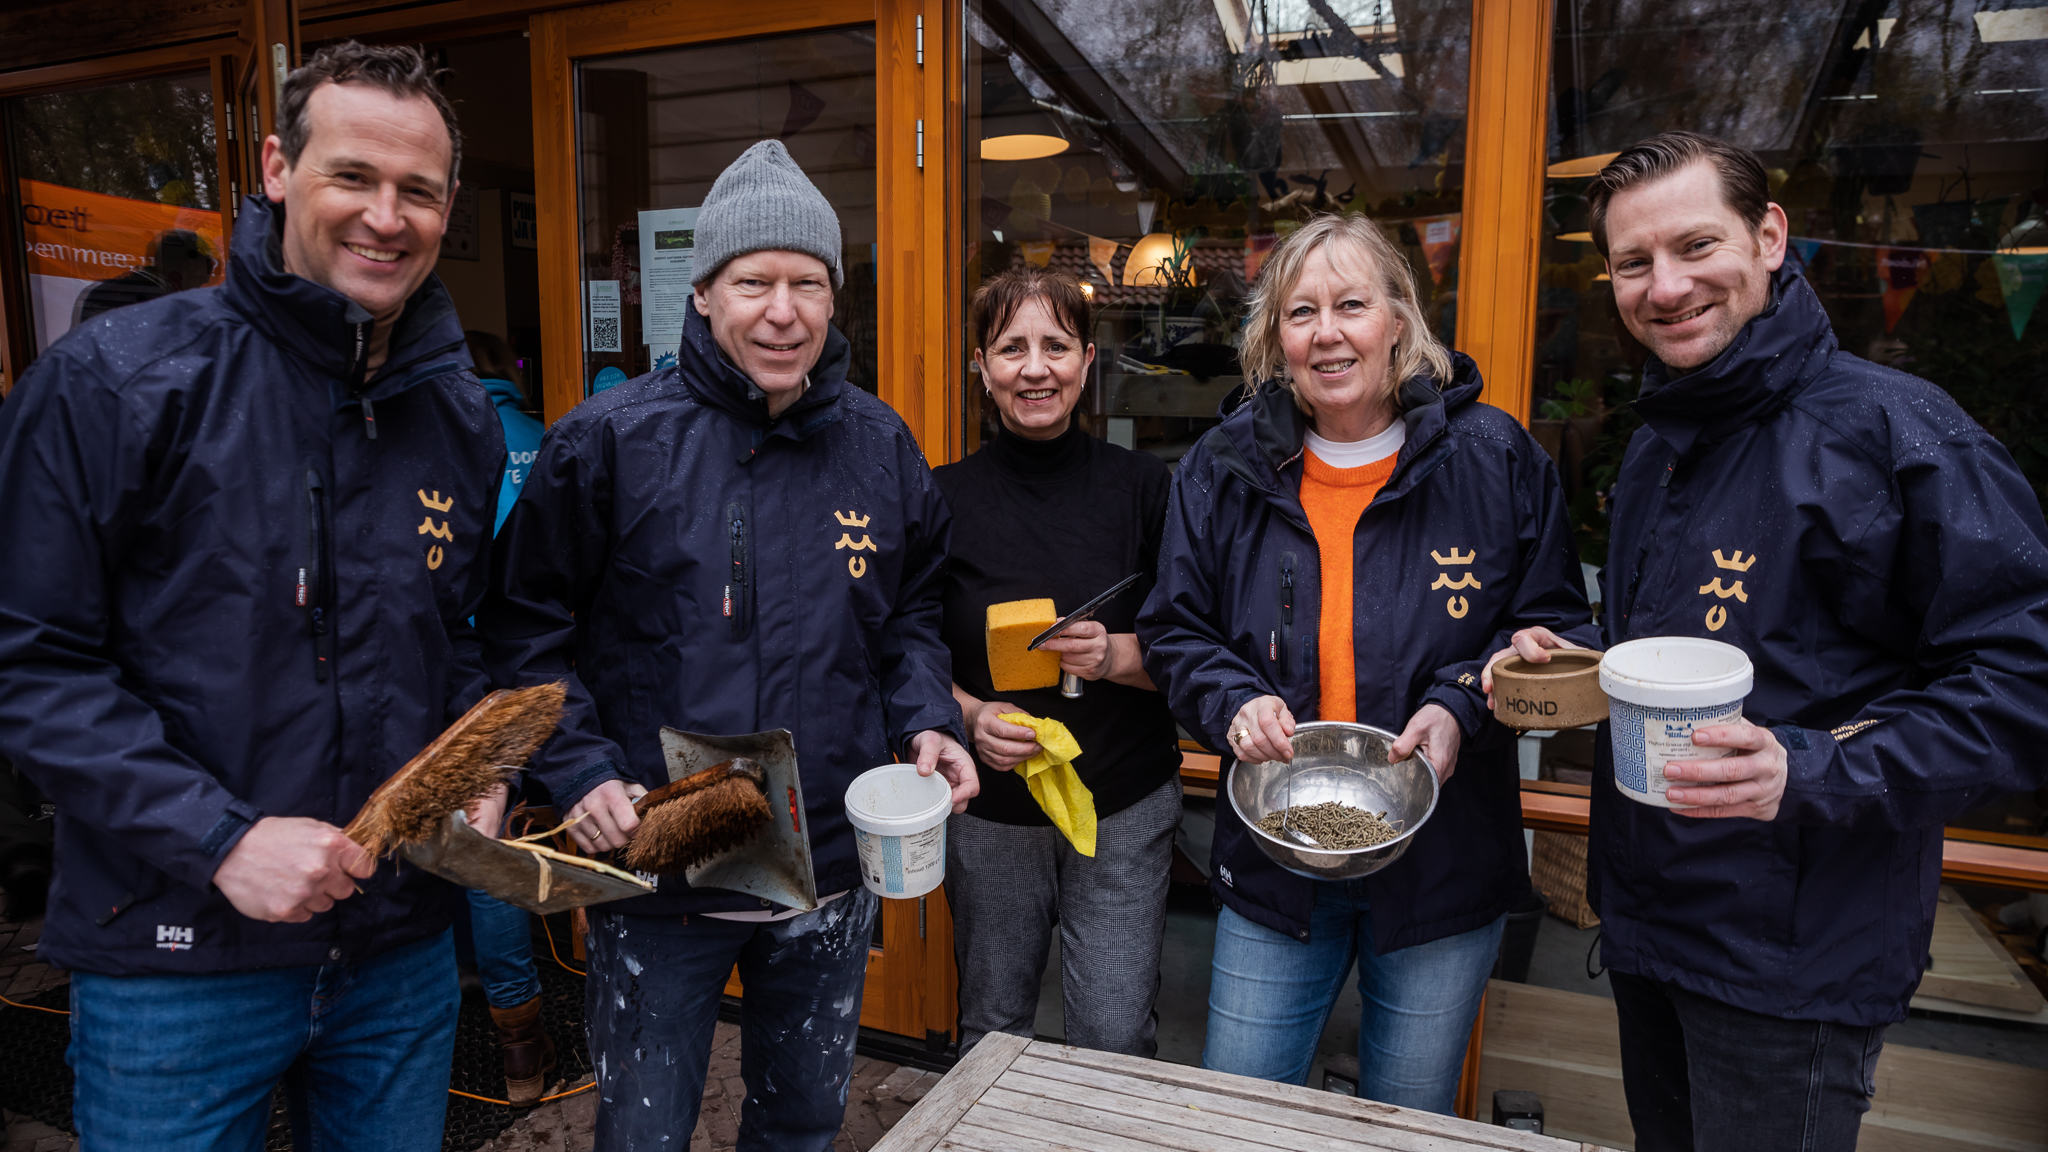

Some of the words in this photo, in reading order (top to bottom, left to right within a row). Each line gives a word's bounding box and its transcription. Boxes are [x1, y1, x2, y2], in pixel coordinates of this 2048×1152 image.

[514, 221, 528, 239] JA
[1506, 696, 1559, 716] HOND
[156, 925, 194, 943] HH
